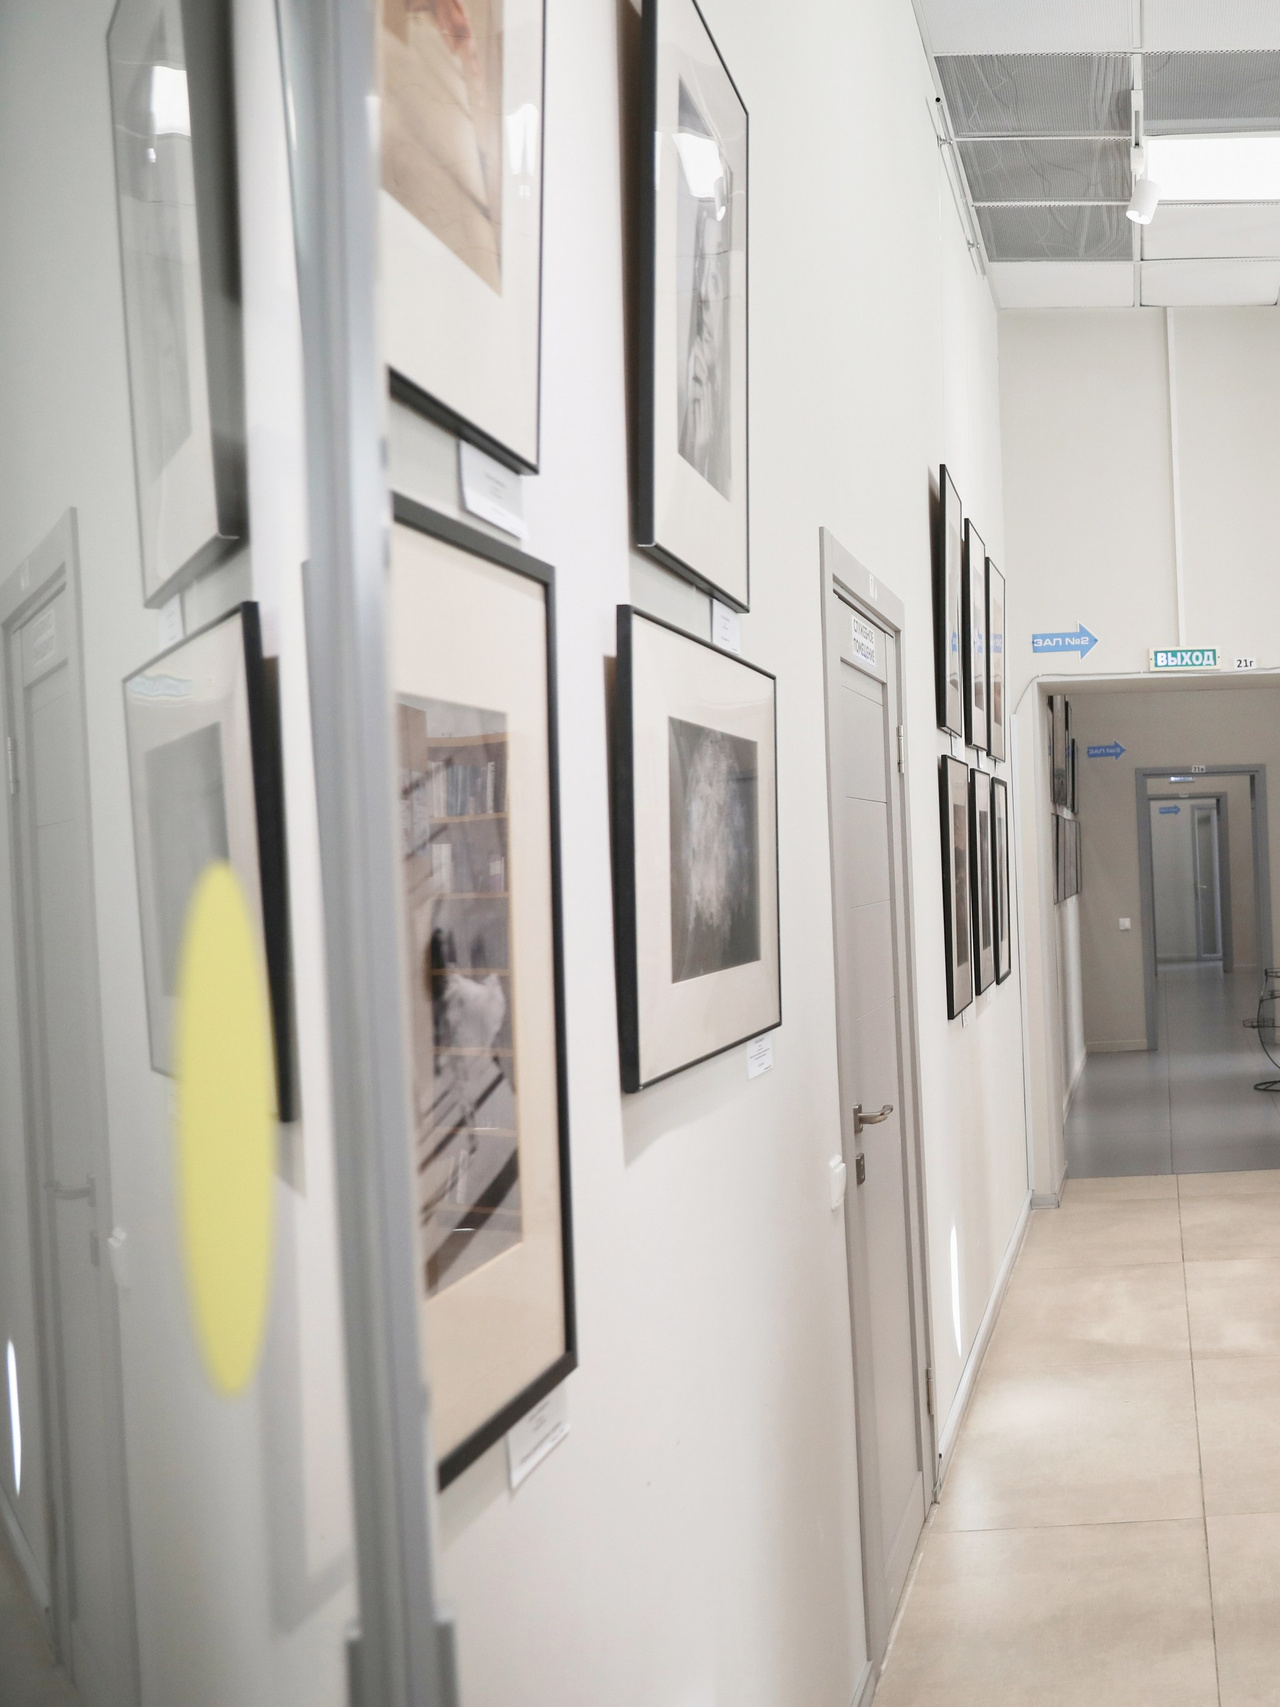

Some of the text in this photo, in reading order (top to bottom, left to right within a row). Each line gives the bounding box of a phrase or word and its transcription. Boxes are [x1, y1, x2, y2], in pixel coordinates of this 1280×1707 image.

[1033, 636, 1090, 647] ЗАЛ №2
[1156, 650, 1216, 667] ВЫХОД
[1236, 658, 1254, 669] 21г
